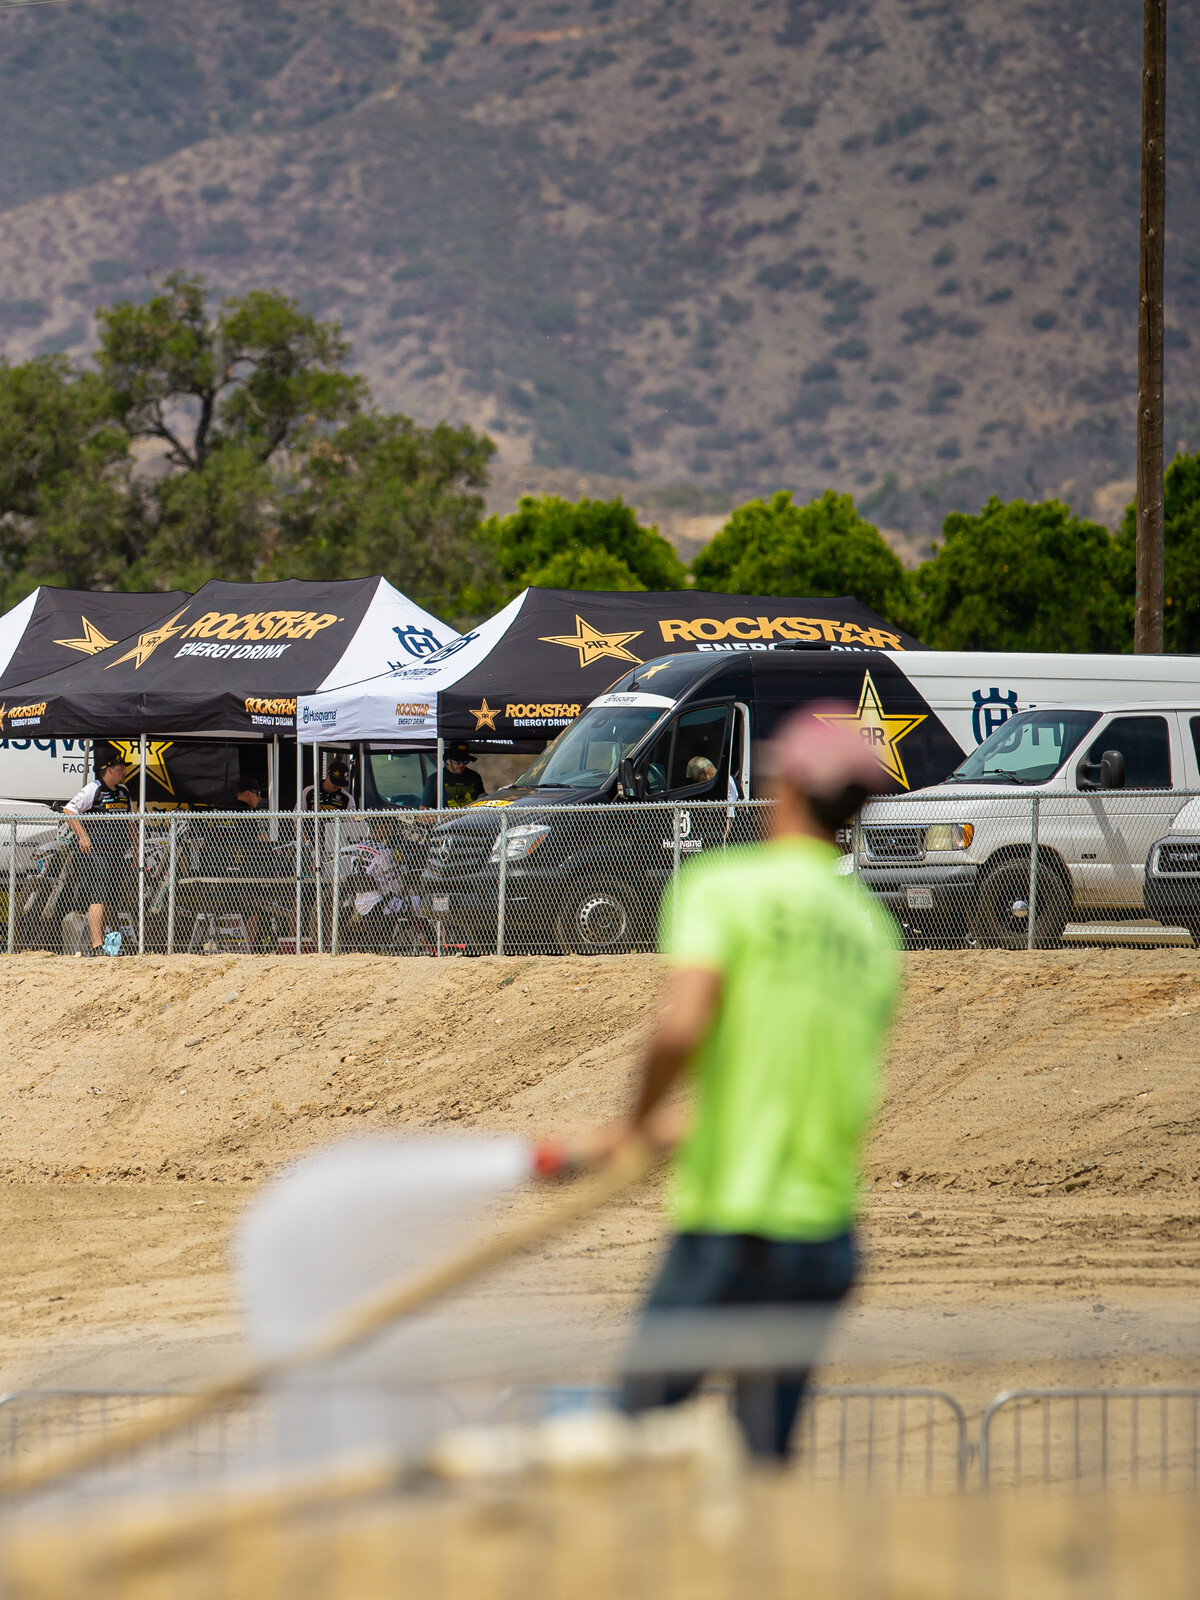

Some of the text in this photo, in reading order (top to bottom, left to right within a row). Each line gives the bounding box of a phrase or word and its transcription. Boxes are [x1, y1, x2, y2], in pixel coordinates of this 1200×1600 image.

[180, 610, 338, 640] ROCKSTAR
[658, 616, 905, 651] ROCKSTAR
[174, 642, 292, 660] ENERGY DRINK
[8, 702, 47, 718] ROCKSTAR
[245, 697, 296, 715] ROCKSTAR
[395, 703, 429, 717] ROCKSTAR
[505, 703, 581, 718] ROCKSTAR
[251, 715, 293, 726] ENERGY DRINK
[309, 709, 336, 723] Husqvarna
[513, 718, 547, 727] ENERGY
